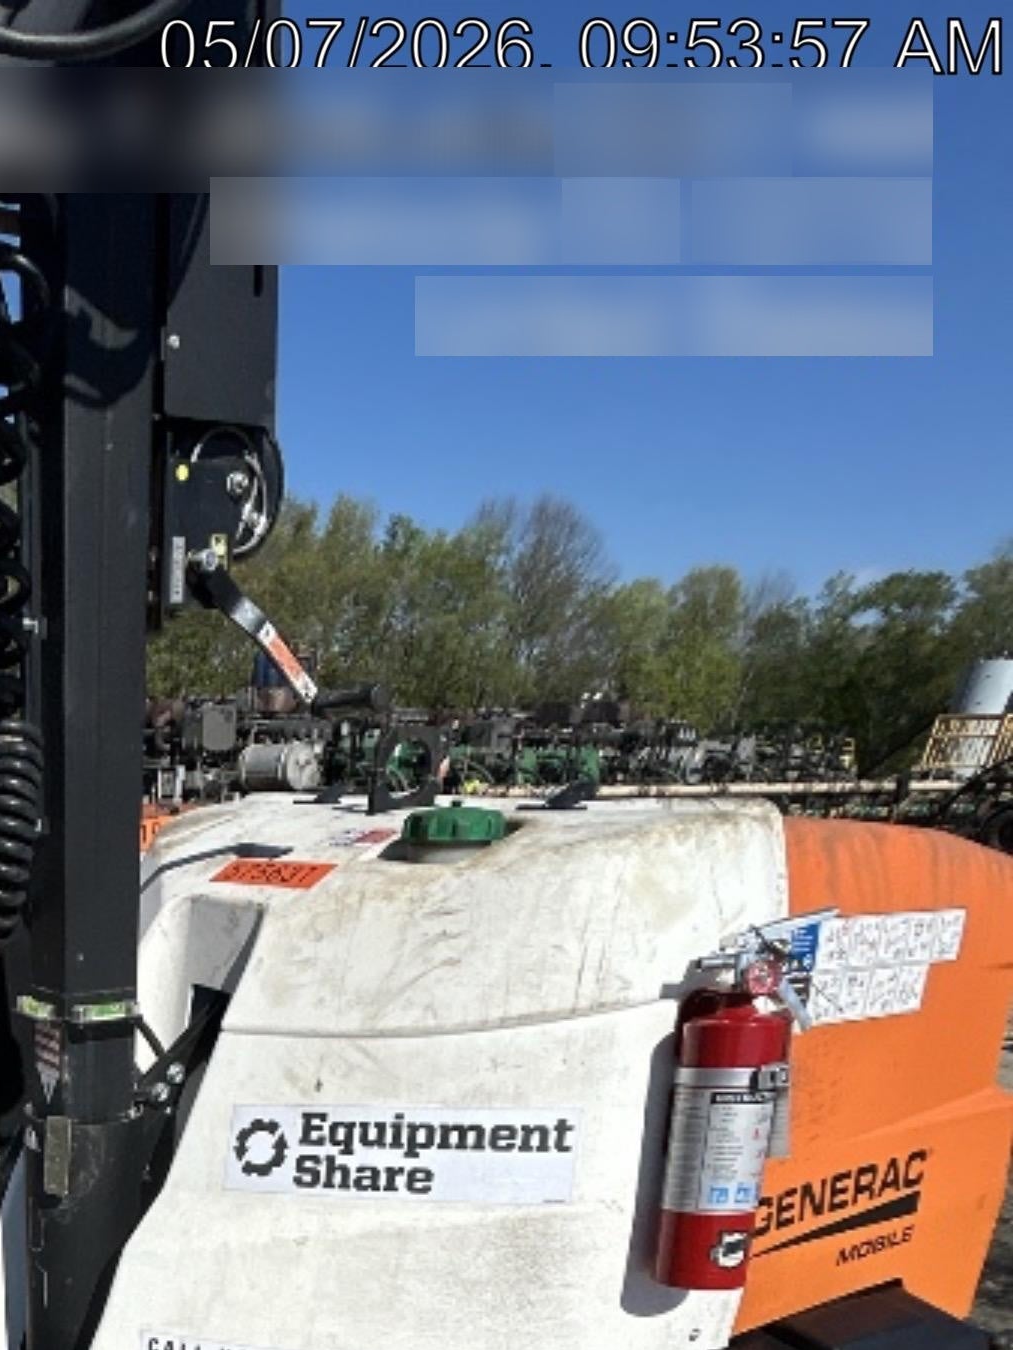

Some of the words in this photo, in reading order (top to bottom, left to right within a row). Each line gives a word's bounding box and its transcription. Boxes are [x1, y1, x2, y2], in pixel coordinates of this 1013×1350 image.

[297, 1112, 574, 1158] Equipment
[292, 1154, 435, 1194] Share
[752, 1149, 928, 1239] GENERAC
[835, 1224, 915, 1267] MOBILE
